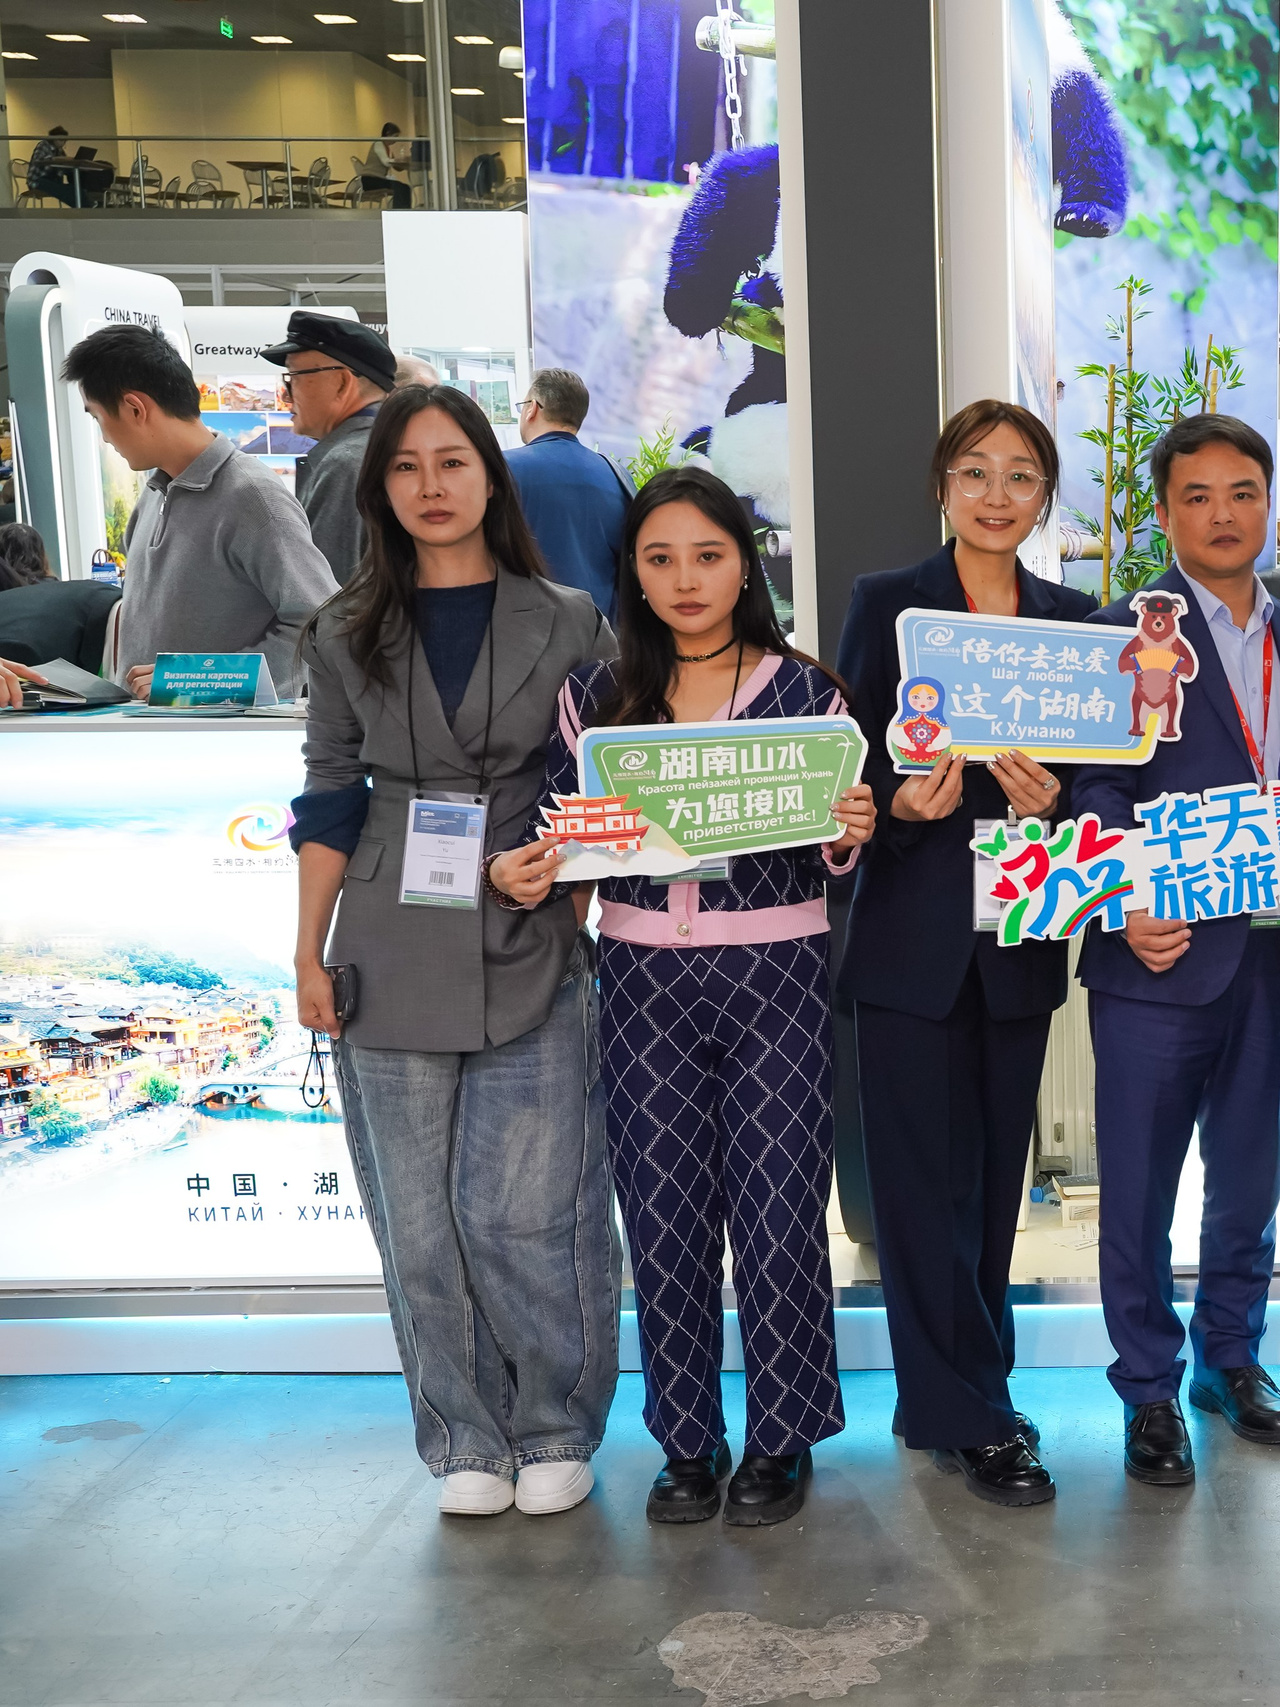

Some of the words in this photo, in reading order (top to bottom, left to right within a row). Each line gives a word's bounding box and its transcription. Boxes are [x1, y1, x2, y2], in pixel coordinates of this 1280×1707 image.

[104, 307, 131, 324] CHINA
[194, 343, 260, 359] Greatway
[961, 638, 1111, 675] 陪你去热爱
[164, 671, 206, 680] Визитная
[207, 672, 249, 681] карточка
[166, 681, 184, 690] для
[185, 681, 243, 690] регистрации
[992, 667, 1019, 681] Шаг
[1026, 667, 1074, 683] любви
[950, 683, 1116, 723] 这个湖南
[990, 722, 1003, 737] К
[1006, 722, 1076, 742] Хунаню
[658, 742, 807, 781] 湖南山水
[638, 779, 685, 796] Красота
[688, 776, 741, 791] пейзажей
[743, 772, 800, 787] провинции
[801, 770, 834, 784] Хунань
[666, 785, 805, 830] 为您接风
[683, 815, 785, 842] приветствует
[789, 809, 817, 823] вас!
[1140, 788, 1271, 860] 华天
[1149, 850, 1279, 920] 旅游
[188, 1202, 264, 1222] КИТАЙ
